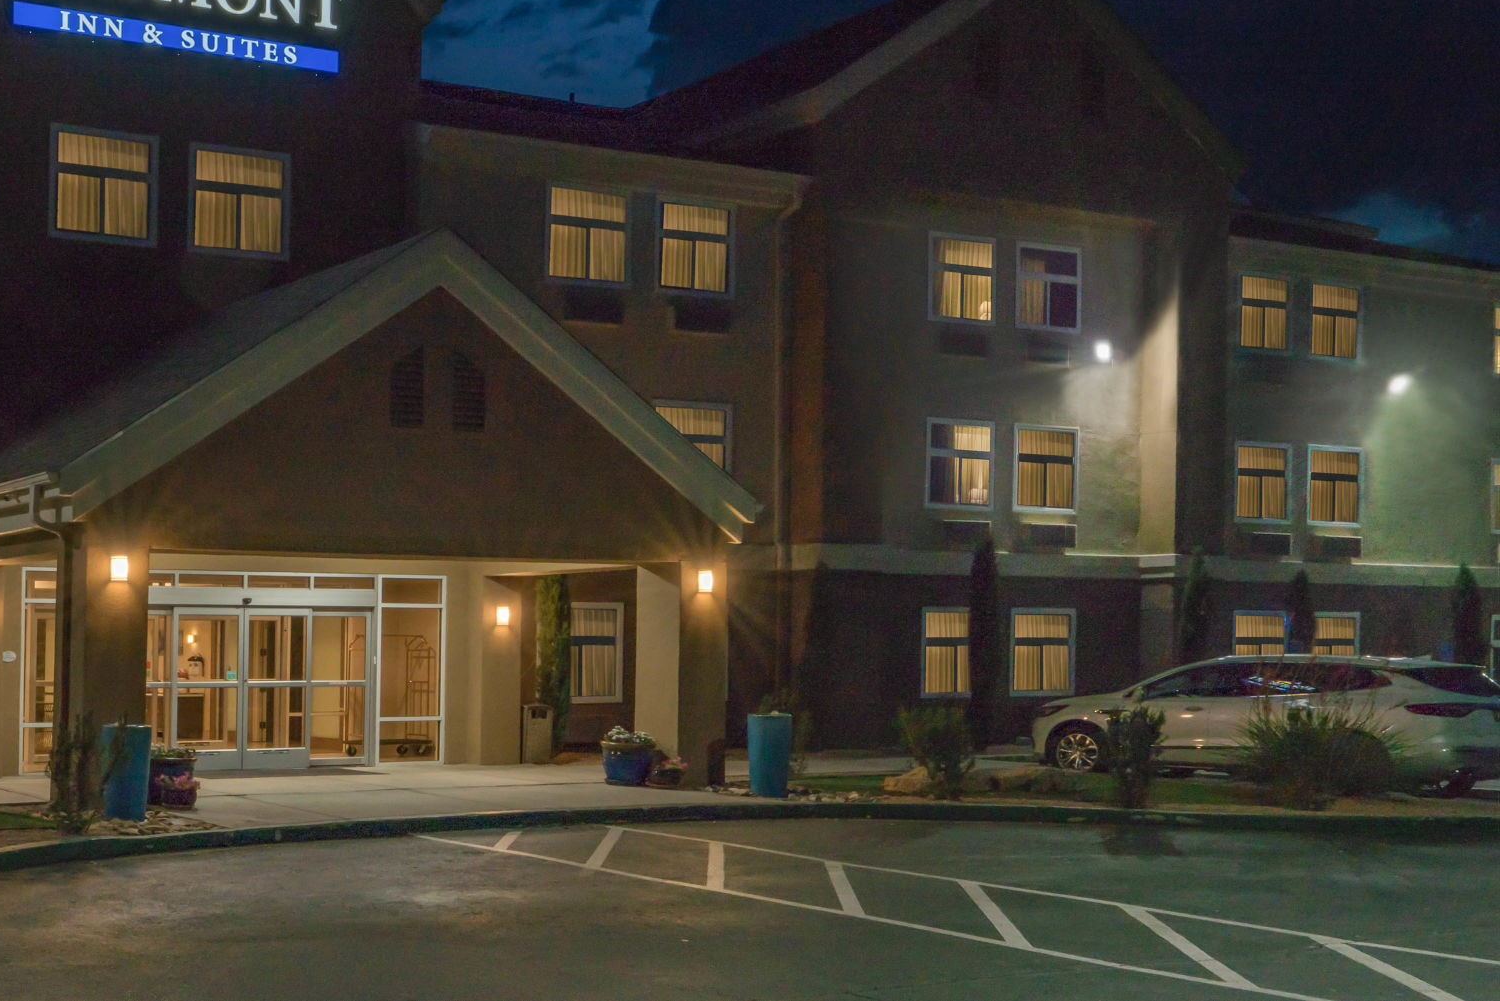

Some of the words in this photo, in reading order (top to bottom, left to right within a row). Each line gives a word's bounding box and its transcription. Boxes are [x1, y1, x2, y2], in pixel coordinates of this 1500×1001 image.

[60, 10, 125, 38] INN
[142, 23, 163, 45] &
[181, 30, 298, 64] SUITES
